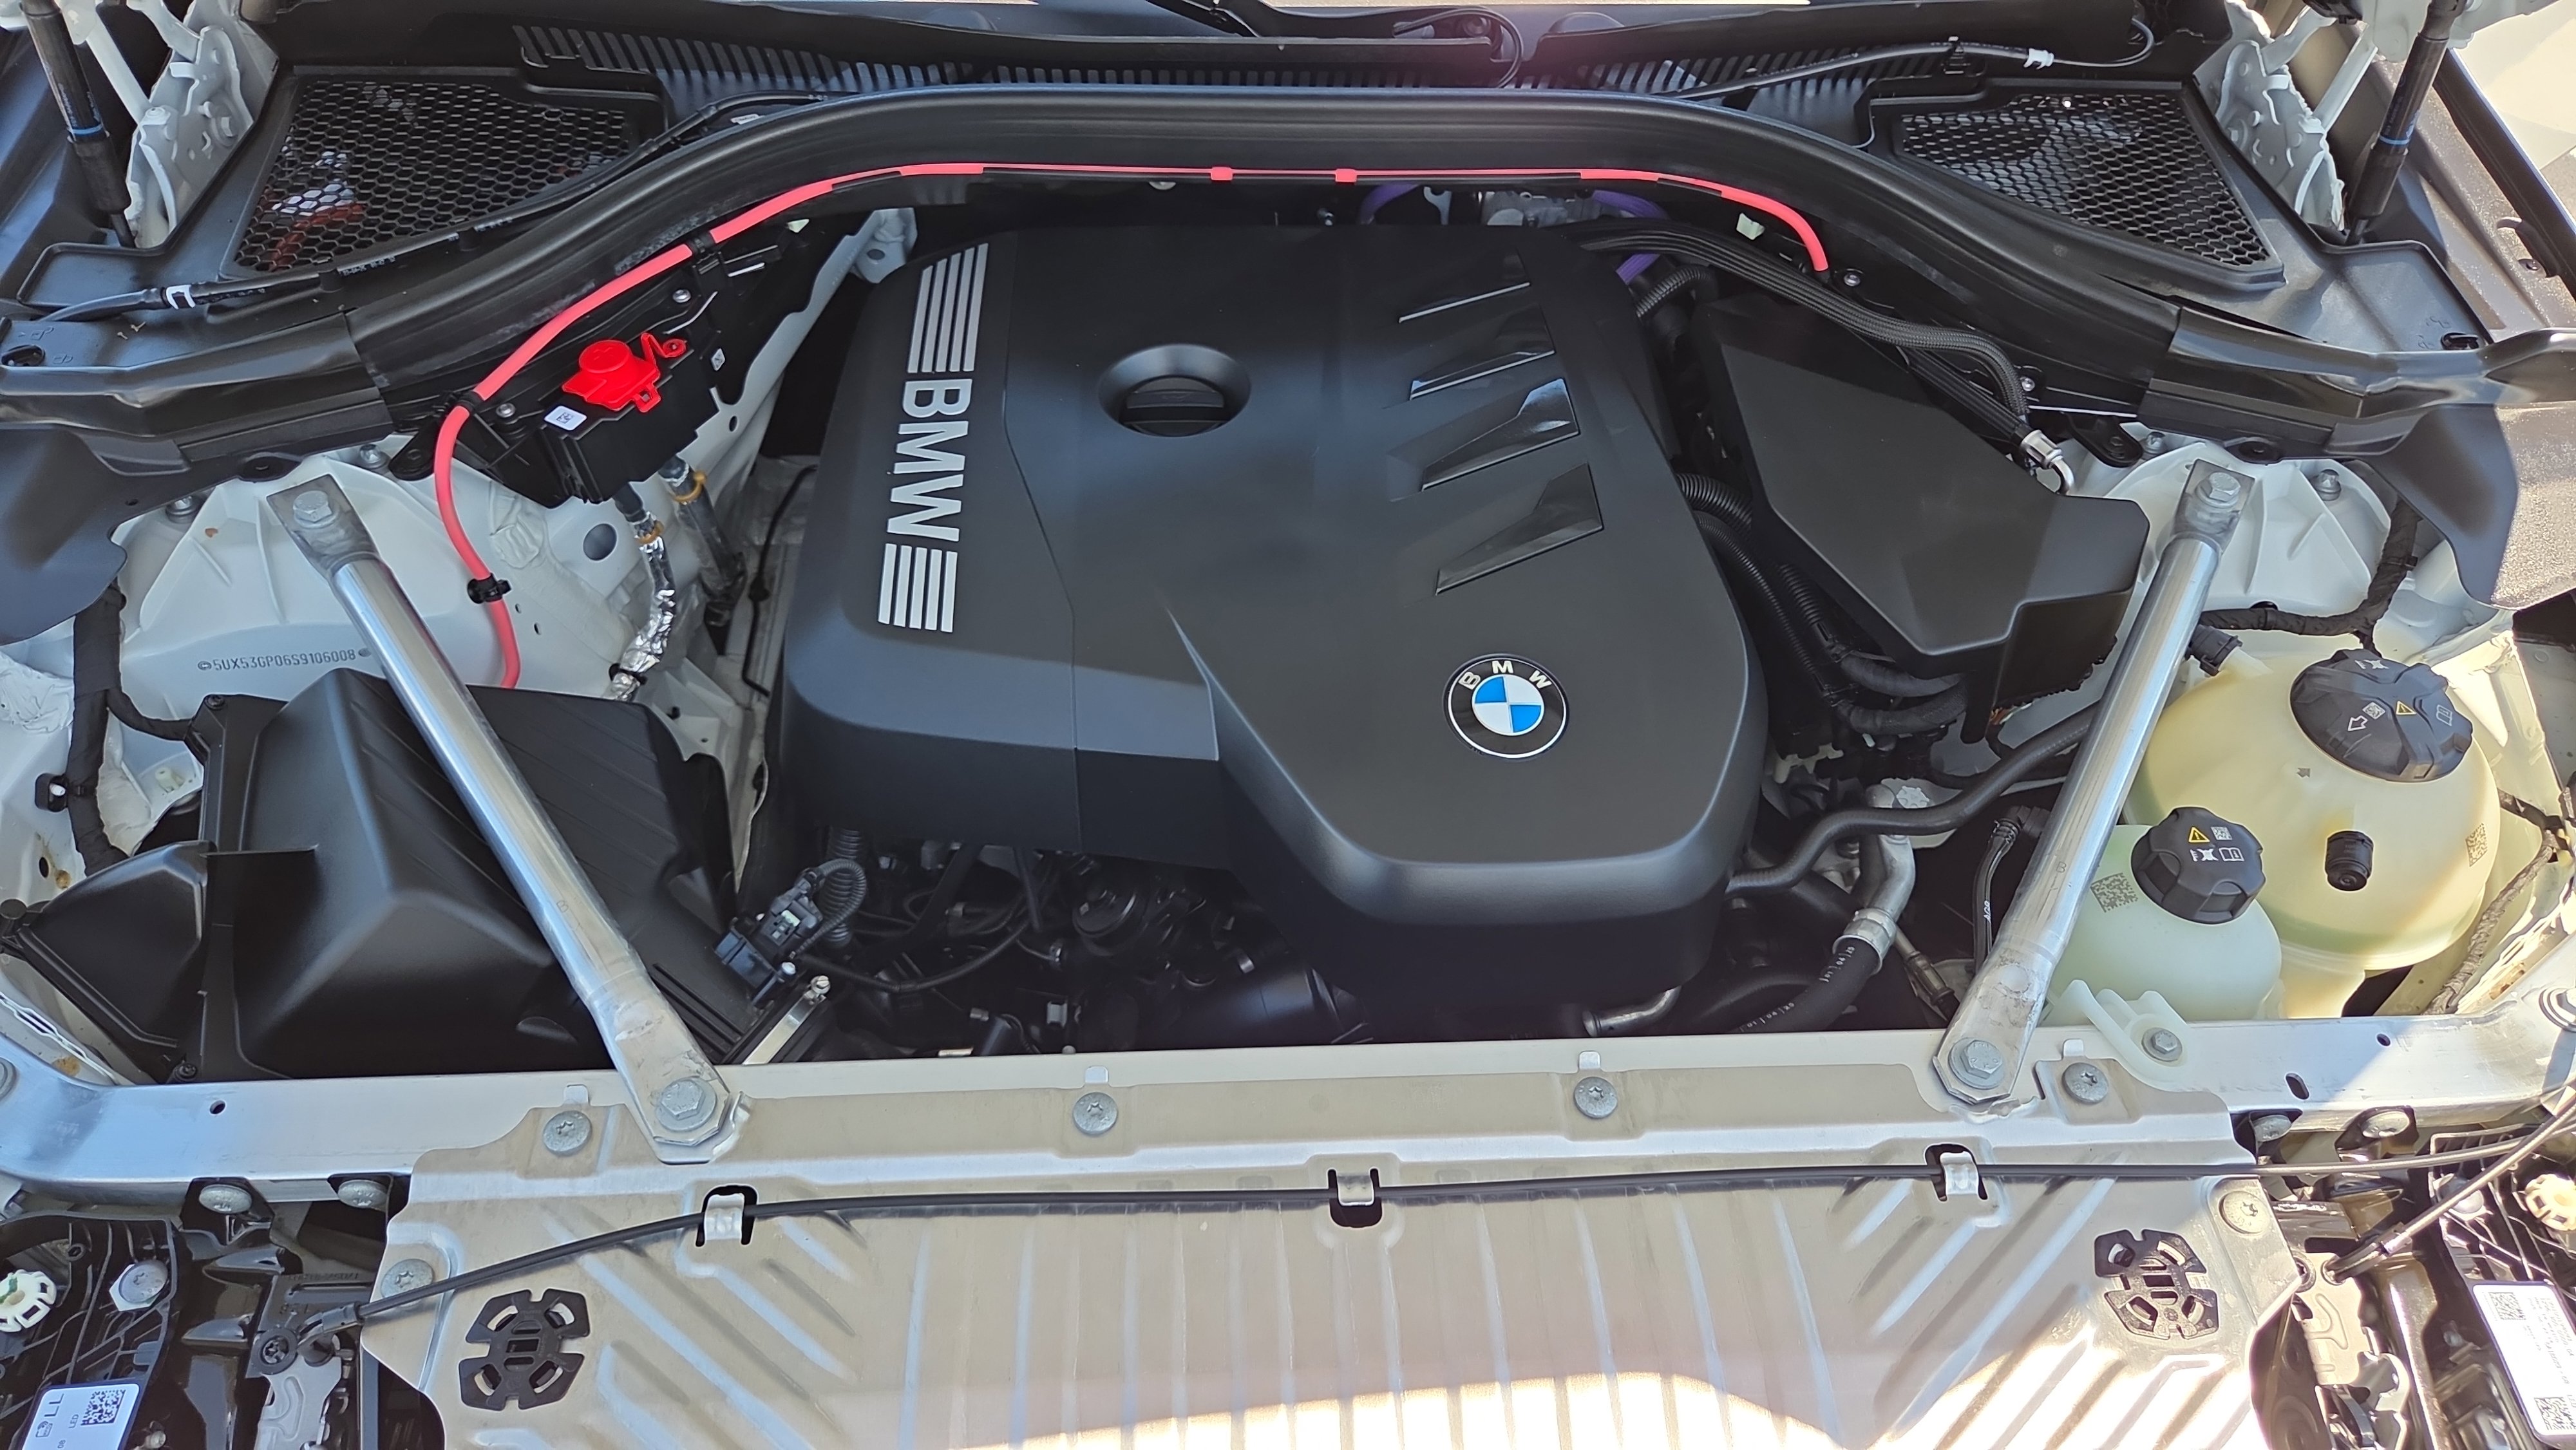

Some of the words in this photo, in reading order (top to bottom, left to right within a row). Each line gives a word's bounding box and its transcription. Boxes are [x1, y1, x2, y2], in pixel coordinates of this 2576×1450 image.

[888, 379, 972, 542] BMW
[212, 649, 356, 671] 5UX53GP06S9106008
[1458, 660, 1552, 690] BMW
[68, 1414, 79, 1429] LED
